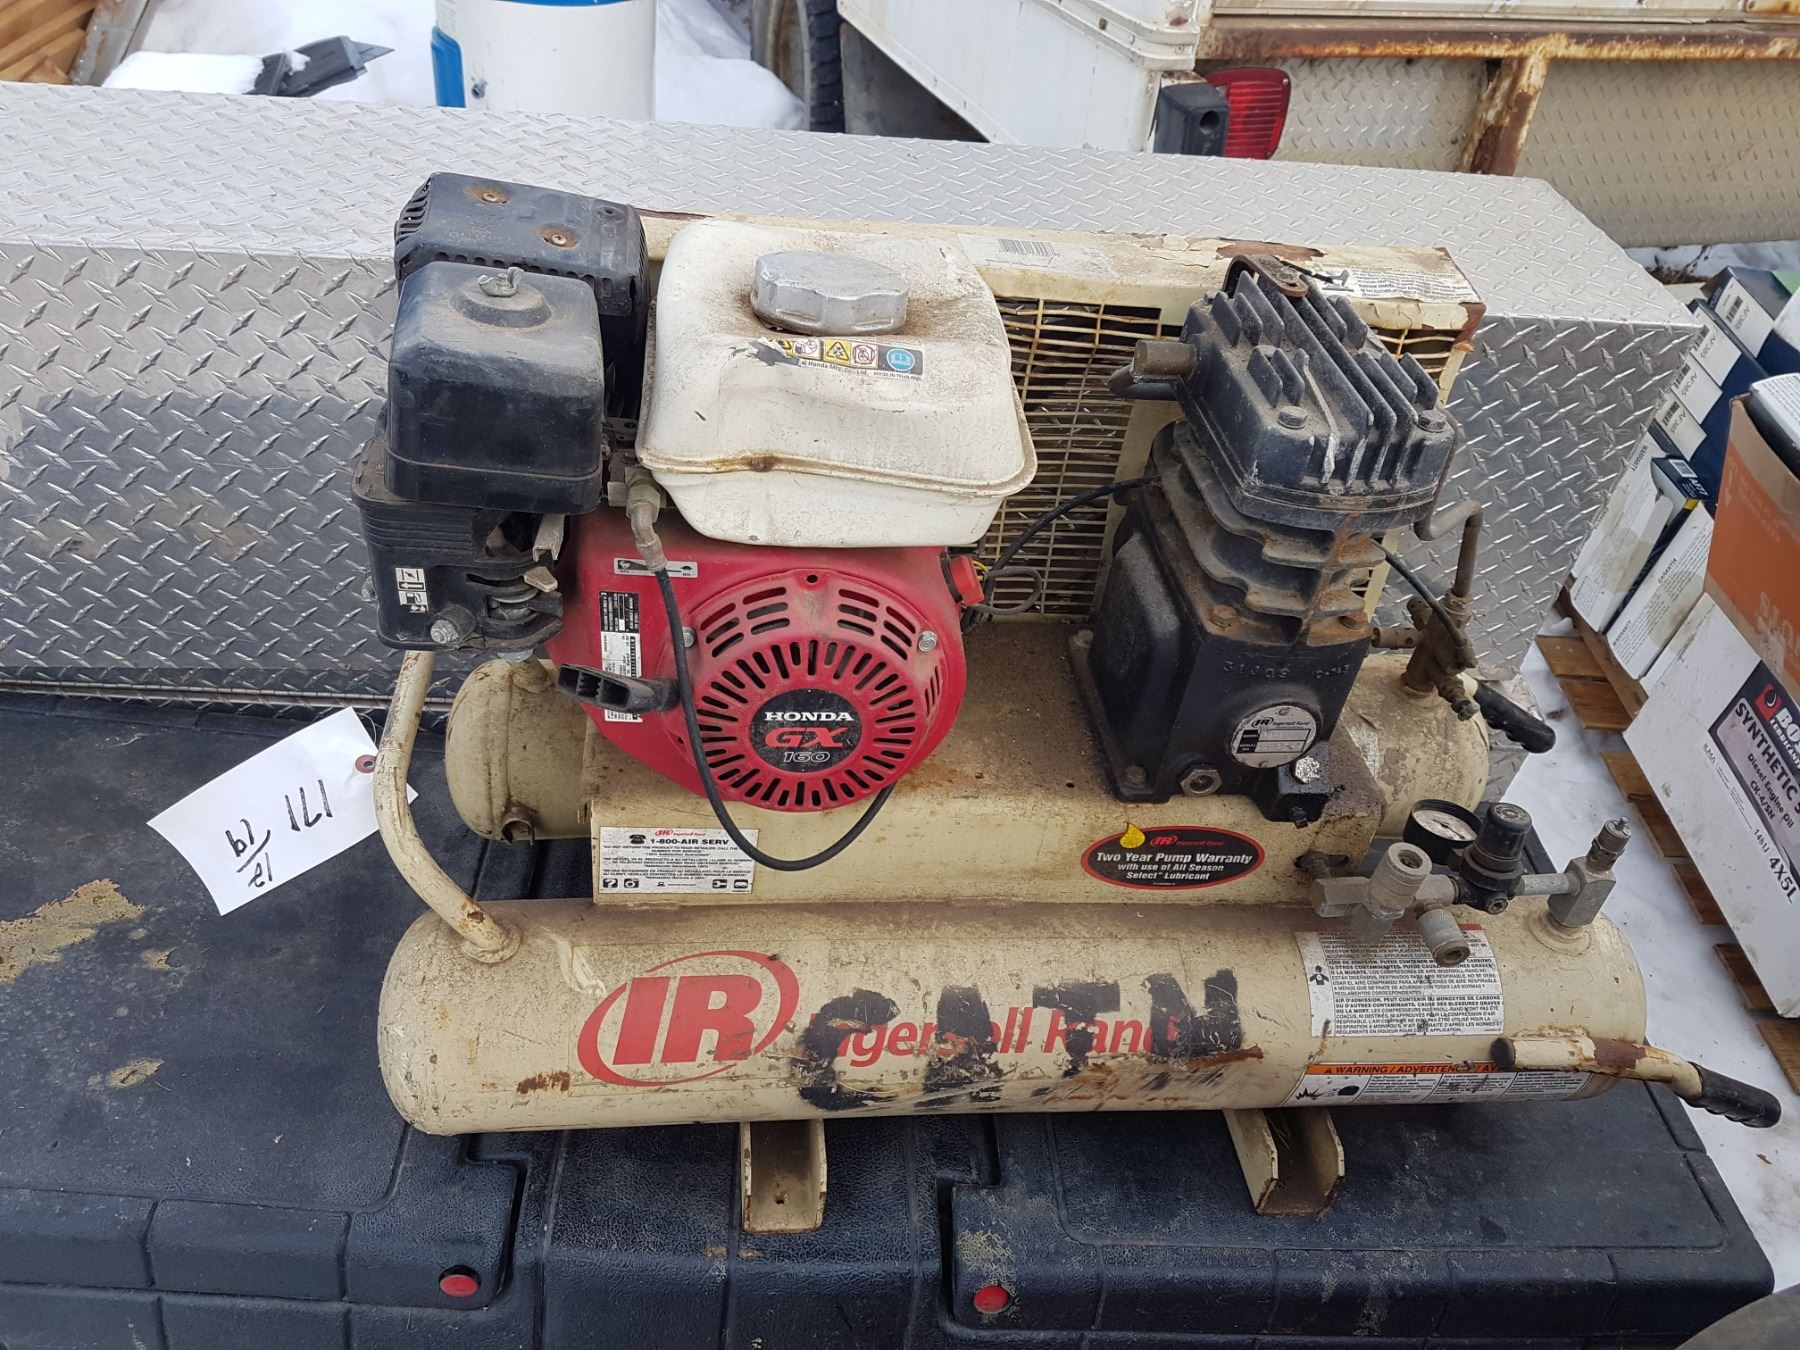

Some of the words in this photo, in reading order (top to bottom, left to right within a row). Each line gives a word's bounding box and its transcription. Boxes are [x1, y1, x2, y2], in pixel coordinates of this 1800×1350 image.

[765, 711, 854, 722] HONDA
[765, 726, 849, 748] GX
[783, 751, 831, 763] 160
[1735, 702, 1798, 801] SYNTHETIC
[1747, 753, 1767, 783] Diesel
[1764, 780, 1784, 813] Engine
[284, 780, 333, 832] 171
[1096, 852, 1121, 862] Two
[1124, 852, 1152, 862] Year
[1155, 853, 1191, 863] Pump
[1195, 853, 1253, 864] Warranty
[1118, 863, 1139, 871] with
[1189, 864, 1224, 872] Season
[1164, 872, 1210, 880] Lubricant
[1769, 857, 1797, 904] 4X5L
[613, 974, 764, 1065] IR
[1332, 1065, 1388, 1074] WARNING
